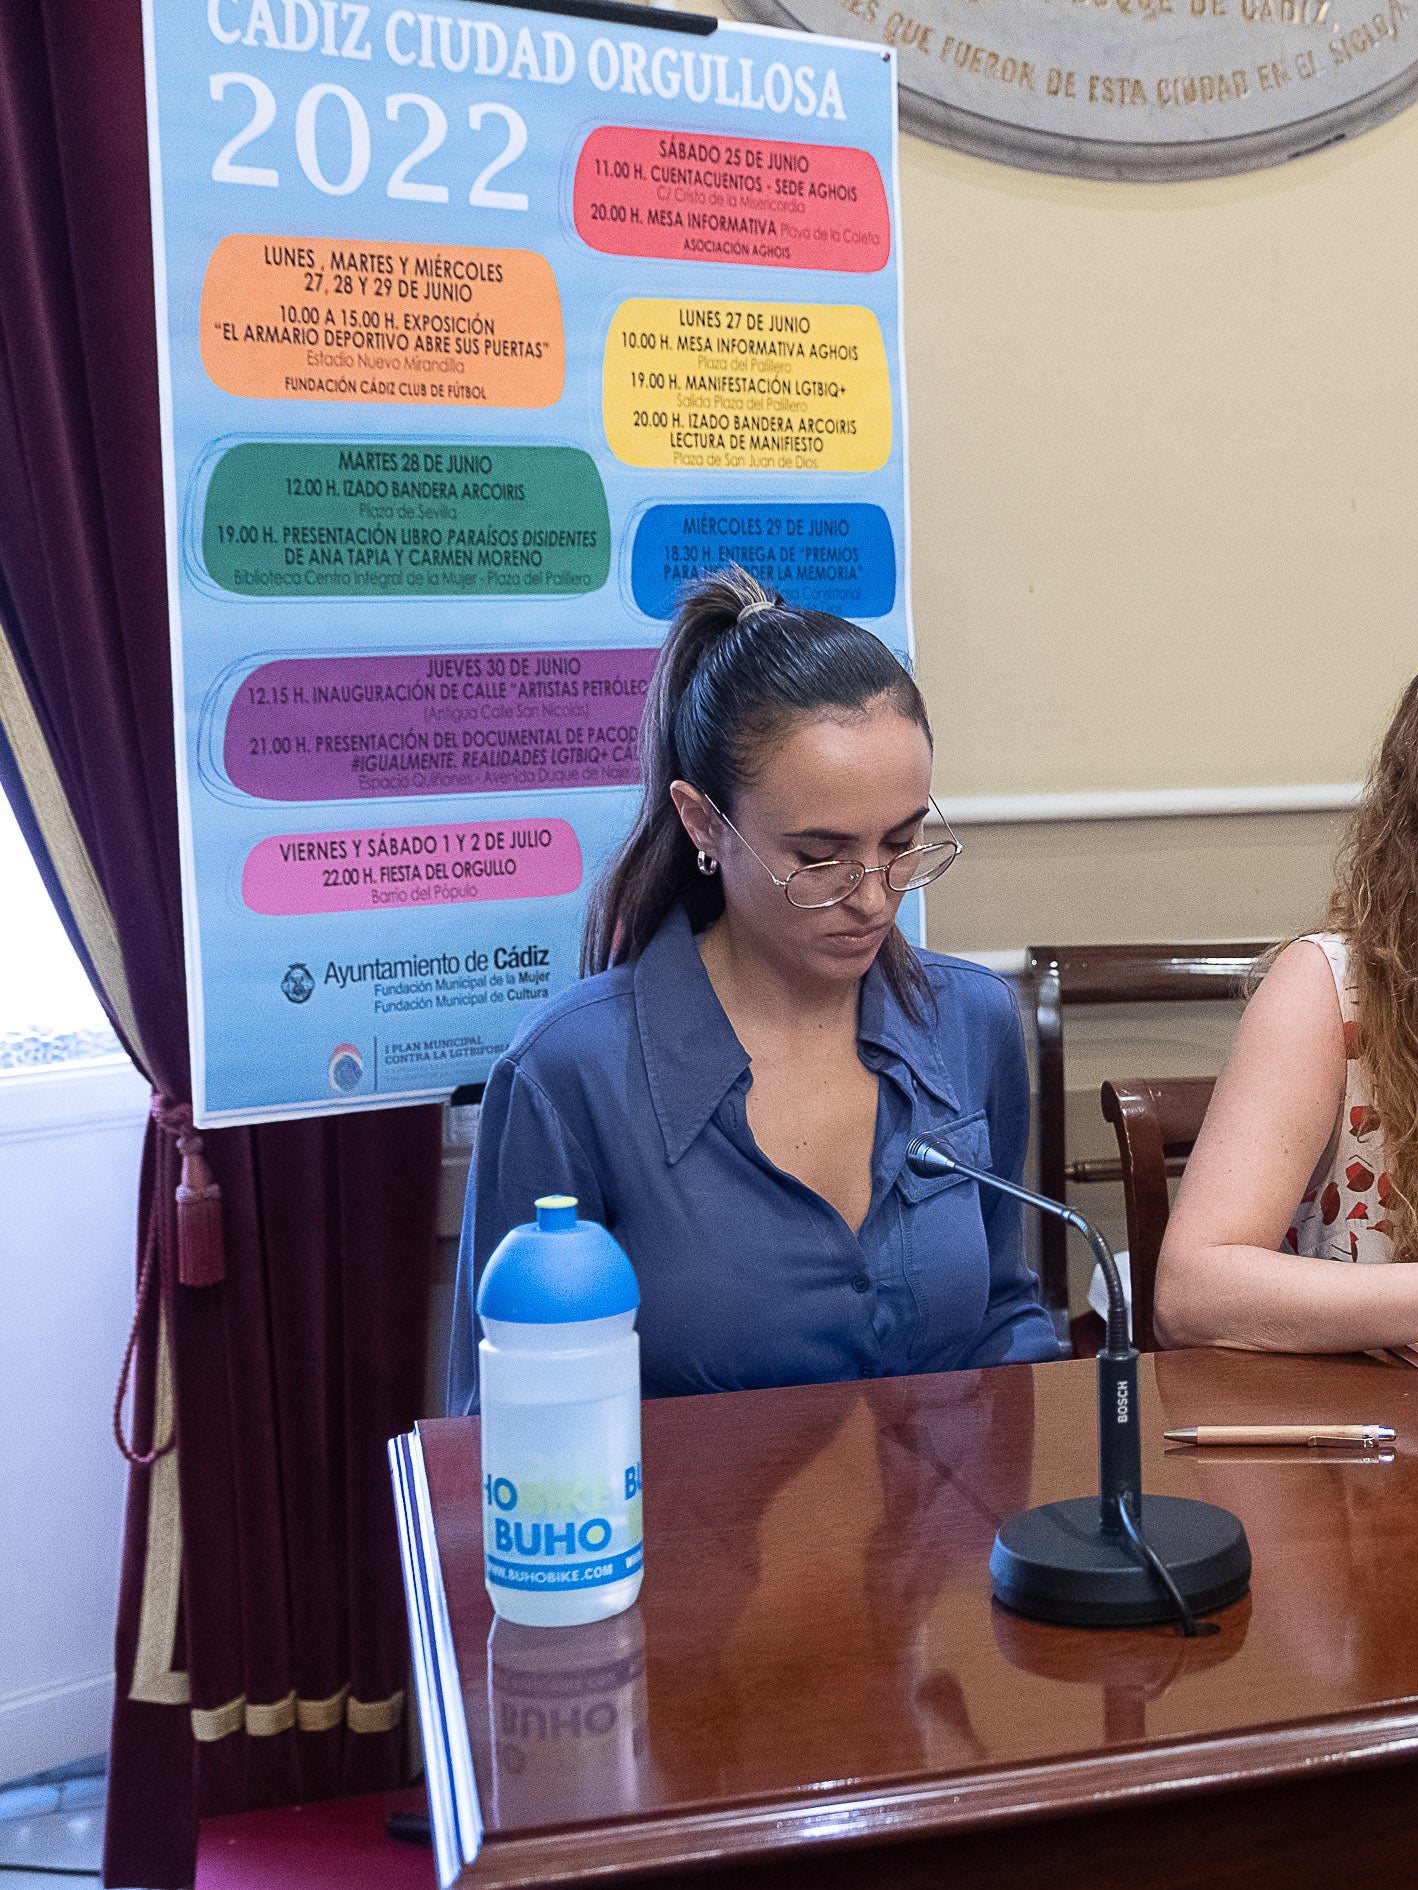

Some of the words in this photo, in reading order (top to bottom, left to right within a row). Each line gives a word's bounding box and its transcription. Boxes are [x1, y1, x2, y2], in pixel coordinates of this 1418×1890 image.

[385, 9, 576, 85] CIUDAD
[588, 38, 847, 120] ORGULLOSA
[208, 71, 530, 211] 2022
[659, 135, 720, 164] SÁBADO
[725, 148, 740, 166] 25
[746, 149, 762, 168] DE
[767, 152, 809, 173] JUNIO
[596, 159, 629, 179] 11.00
[634, 161, 647, 181] H.
[651, 165, 762, 192] CUENTACUENTOS
[775, 180, 803, 196] SEDE
[808, 182, 857, 202] AGHOIS
[264, 246, 315, 268] LUNES
[331, 251, 393, 275] MARTES
[415, 253, 503, 283] MIÉRCOLES
[334, 276, 352, 294] 28
[374, 278, 391, 296] 29
[399, 280, 418, 299] DE
[423, 281, 473, 303] JUNIO
[280, 305, 319, 326] 10.00
[341, 309, 380, 328] 15.00
[385, 312, 399, 330] H.
[404, 312, 495, 335] EXPOSICIÓN
[679, 309, 721, 328] LUNES
[726, 312, 741, 329] 27
[747, 314, 763, 331] DE
[769, 315, 810, 334] JUNIO
[244, 326, 319, 346] ARMARIO
[324, 331, 409, 351] DEPORTIVO
[414, 335, 450, 353] ABRE
[456, 337, 480, 355] SUS
[622, 332, 656, 349] 10.00
[660, 334, 672, 350] H.
[677, 336, 712, 352] MESA
[717, 338, 805, 357] INFORMATIVA
[810, 344, 858, 361] AGHOIS
[285, 375, 356, 393] FUNDACIÓN
[360, 377, 395, 396] CÁDIZ
[399, 382, 426, 397] CLUB
[430, 384, 444, 398] DE
[448, 383, 486, 400] FÚTBOL
[630, 372, 664, 388] 19.00
[669, 374, 680, 390] H.
[686, 374, 791, 395] MANIFESTACIÓN
[796, 380, 846, 398] LGTBIQ+
[633, 411, 667, 428] 20.00
[672, 413, 684, 428] H.
[689, 414, 729, 430] IZADO
[734, 414, 793, 432] BANDERA
[670, 432, 725, 450] LECTURA
[730, 434, 746, 450] DE
[750, 436, 824, 453] MANIFIESTO
[338, 452, 398, 472] MARTES
[400, 454, 419, 473] 28
[424, 455, 442, 474] DE
[446, 455, 492, 475] JUNIO
[286, 478, 322, 496] 12.00
[326, 479, 340, 497] H.
[343, 480, 387, 498] IZADO
[392, 481, 456, 499] BANDERA
[217, 525, 259, 544] 19.00
[263, 526, 278, 544] H.
[283, 524, 397, 546] PRESENTACIÓN
[401, 529, 442, 546] LIBRO
[448, 525, 519, 547] PARAÍSOS
[523, 530, 597, 548] DISIDENTES
[683, 513, 761, 536] MIÉRCOLES
[766, 518, 781, 535] 29
[786, 518, 804, 536] DE
[808, 518, 849, 536] JUNIO
[284, 548, 304, 565] DE
[309, 548, 344, 565] ANA
[348, 548, 391, 566] TAPIA
[409, 549, 473, 566] CARMEN
[478, 550, 543, 567] MORENO
[426, 658, 482, 678] JUEVES
[486, 659, 505, 676] 30
[510, 658, 529, 676] DE
[534, 657, 581, 676] JUNIO
[249, 687, 288, 704] 12.15
[294, 687, 309, 703] H.
[313, 678, 435, 703] INAUGURACIÓN
[440, 682, 458, 700] DE
[462, 681, 506, 699] CALLE
[250, 737, 291, 755] 21.00
[296, 736, 310, 752] H.
[316, 727, 428, 752] PRESENTACIÓN
[279, 837, 347, 863] VIERNES
[368, 831, 437, 857] SÁBADO
[485, 831, 505, 851] DE
[509, 828, 552, 849] JULIO
[323, 868, 360, 887] 22.00
[363, 866, 377, 885] H.
[380, 864, 421, 883] FIESTA
[425, 862, 449, 881] DEL
[453, 858, 516, 878] ORGULLO
[324, 954, 460, 988] Ayuntamiento
[466, 950, 488, 972] de
[493, 945, 549, 970] Cádiz
[374, 979, 433, 997] Fundación
[435, 976, 487, 993] Municipal
[519, 971, 550, 986] Mujer
[374, 996, 433, 1013] Fundación
[436, 994, 487, 1010] Municipal
[507, 987, 548, 1002] Cultura
[1117, 1380, 1128, 1424] BOSCH
[495, 1518, 612, 1556] BUHO
